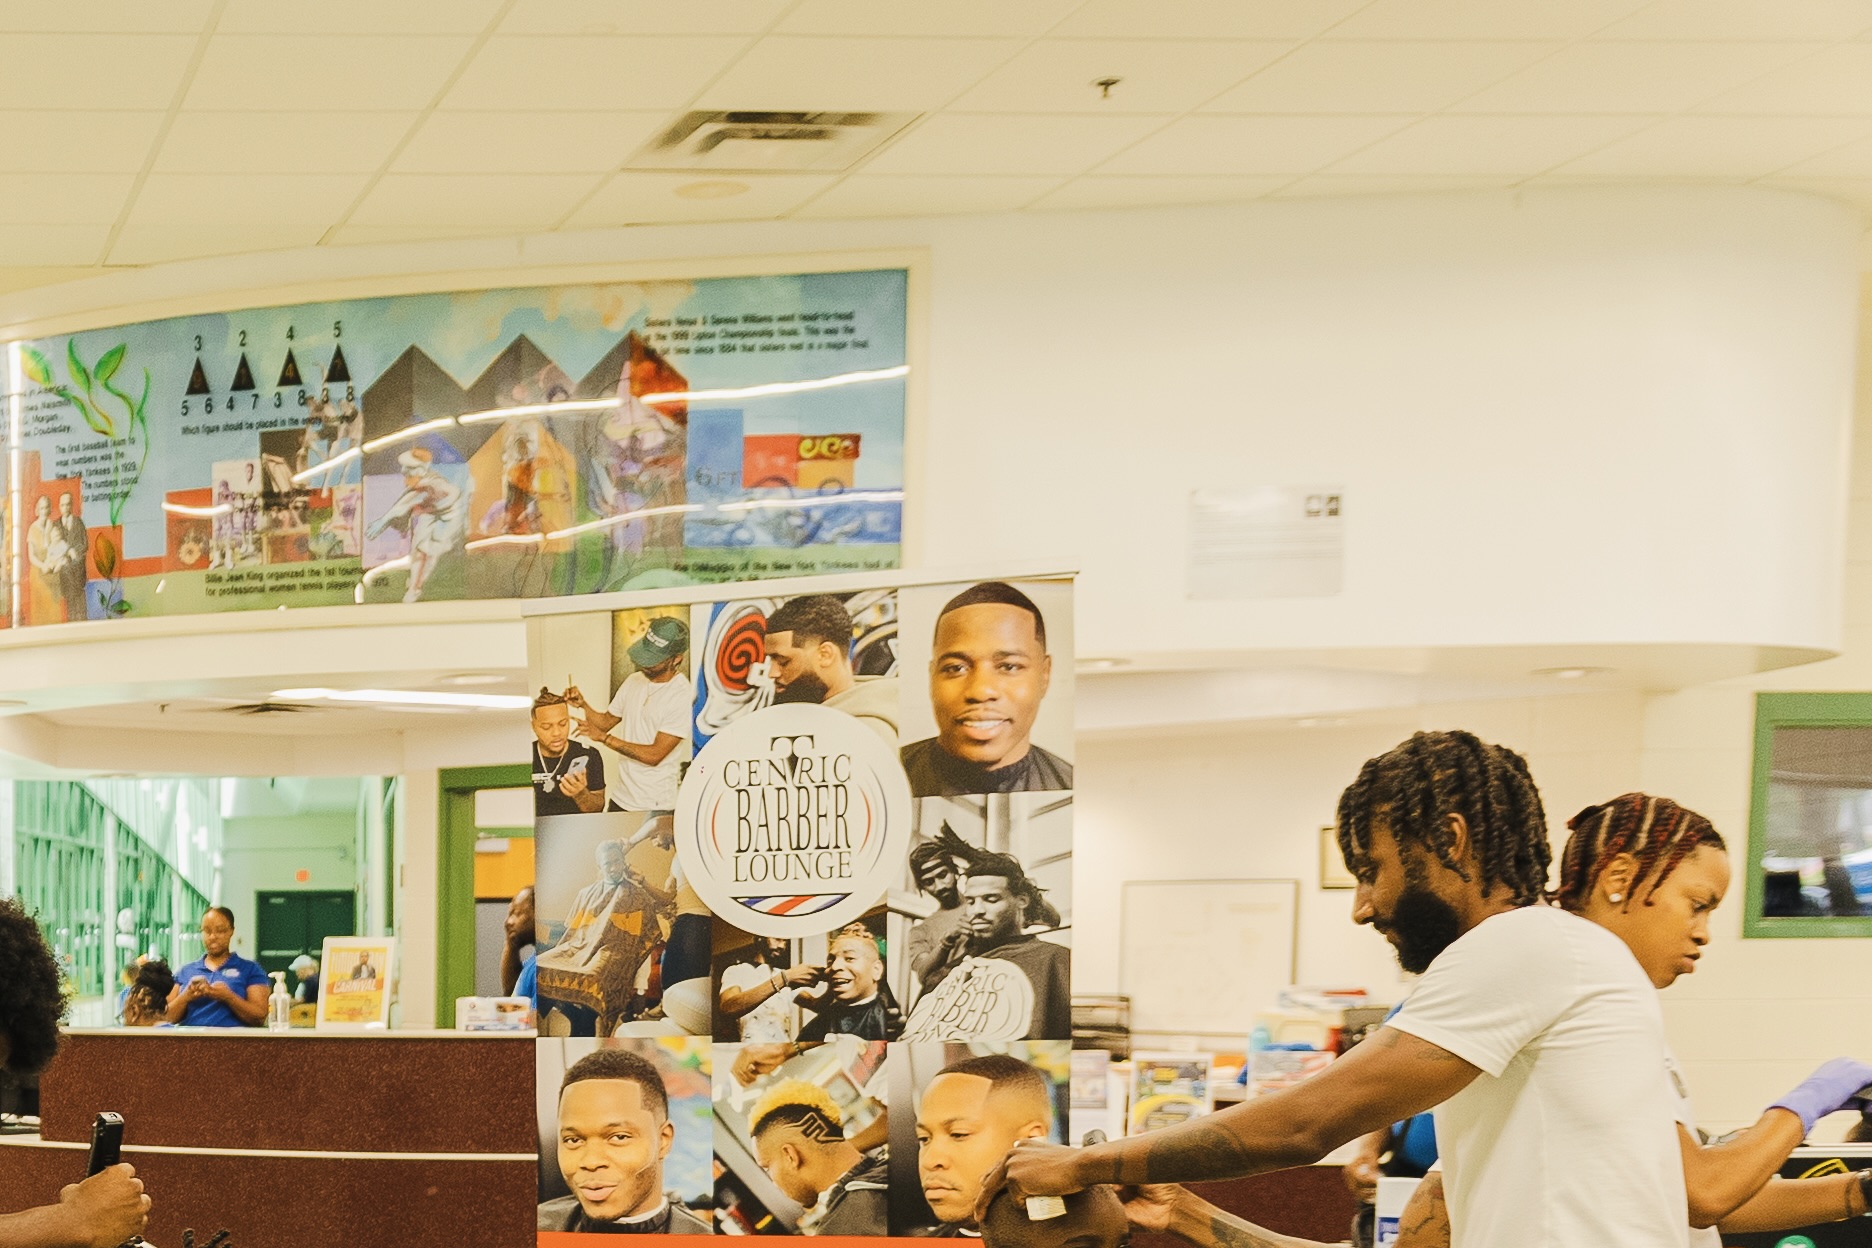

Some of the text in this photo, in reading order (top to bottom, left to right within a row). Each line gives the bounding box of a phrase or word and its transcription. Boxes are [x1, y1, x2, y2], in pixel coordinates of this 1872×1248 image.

[286, 325, 295, 341] 4
[333, 320, 341, 338] 5
[194, 335, 203, 351] 3
[239, 329, 247, 347] 2
[226, 394, 259, 411] 4 7
[273, 389, 307, 408] 3 8
[346, 386, 354, 402] 8
[181, 398, 213, 416] 5 6
[223, 422, 243, 431] should
[256, 419, 278, 431] placed
[288, 417, 299, 427] the
[717, 471, 738, 486] FT
[205, 573, 223, 584] Billie
[225, 572, 244, 583] Jean
[245, 570, 263, 583] King
[266, 567, 305, 581] organized
[307, 567, 320, 577] the
[205, 585, 216, 597] for
[218, 583, 266, 597] professional
[269, 583, 296, 592] women
[299, 580, 323, 591] tennis
[722, 734, 854, 790] CENTRIC
[734, 786, 853, 854] BARBER
[733, 848, 854, 882] LOUNGE
